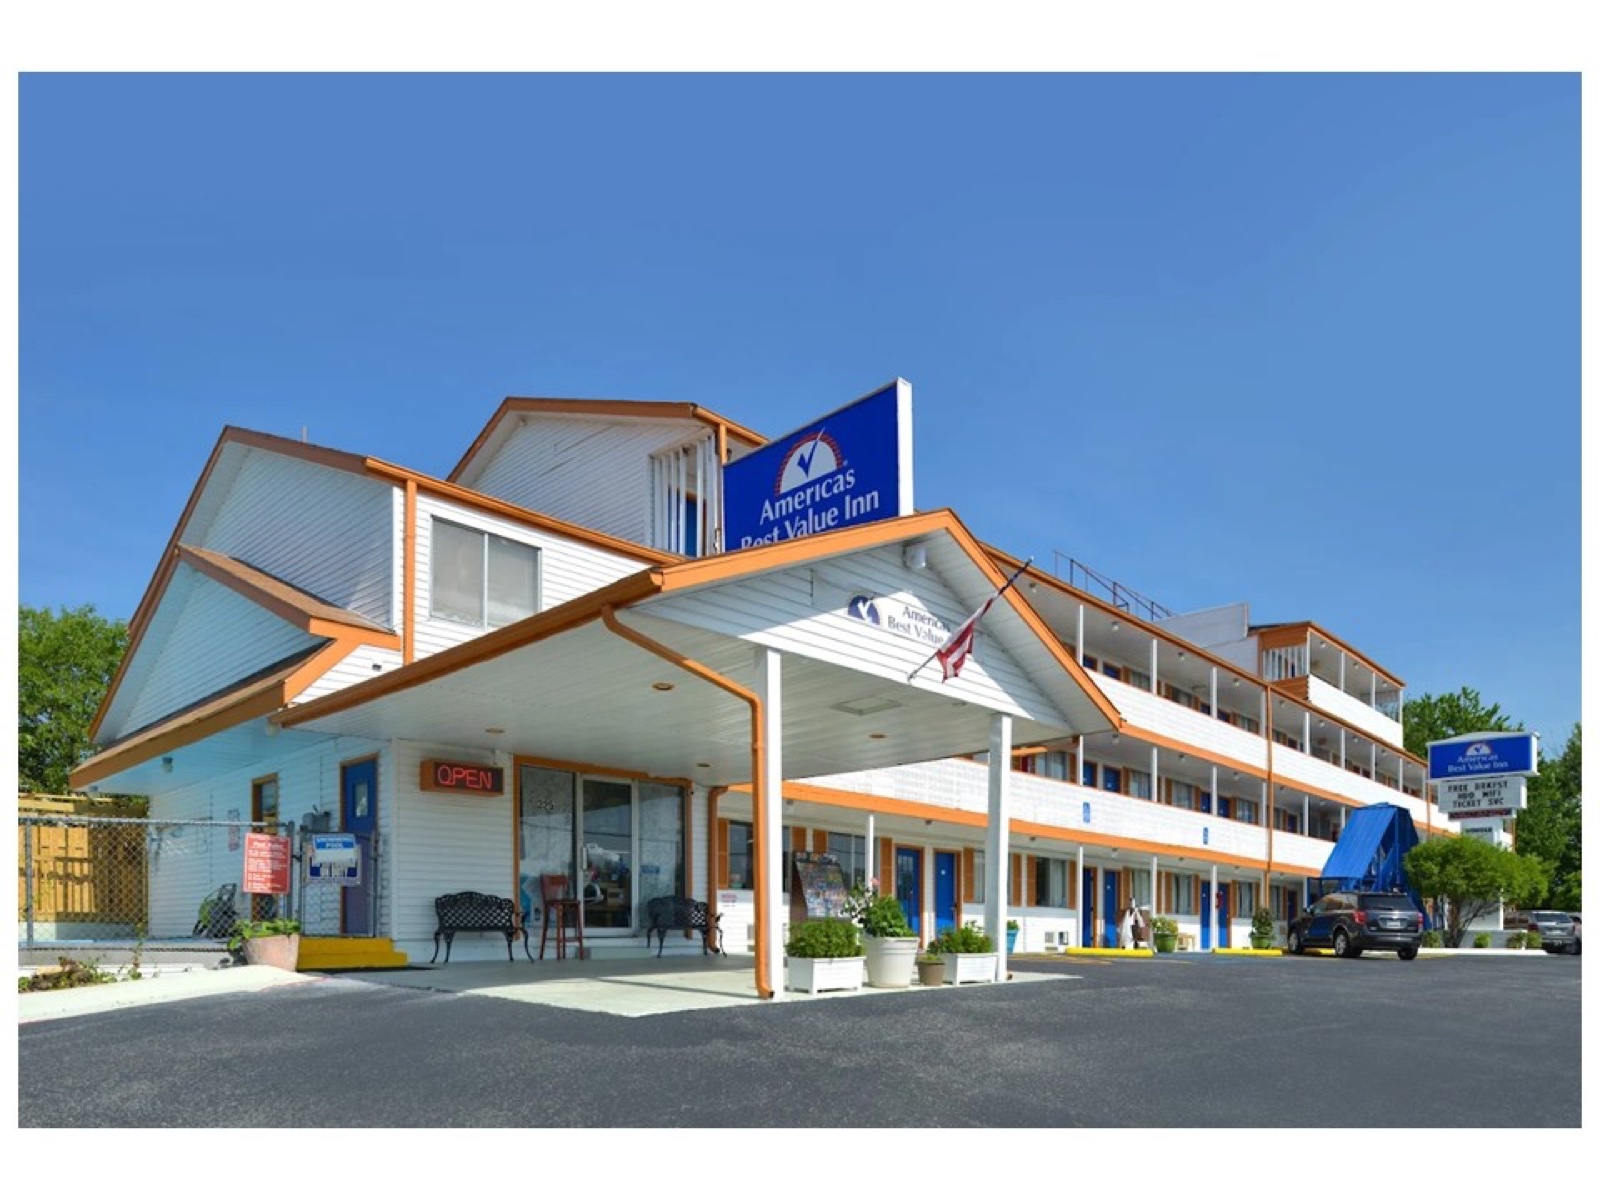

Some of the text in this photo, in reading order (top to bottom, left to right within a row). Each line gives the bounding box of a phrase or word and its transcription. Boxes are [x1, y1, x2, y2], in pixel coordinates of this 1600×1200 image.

[759, 469, 856, 526] Americas
[784, 506, 839, 539] Value
[844, 489, 880, 520] Inn
[887, 615, 944, 644] Best Value
[1447, 764, 1466, 773] Best
[1492, 761, 1509, 769] Inn
[437, 764, 493, 790] OPEN
[1447, 784, 1468, 792] FREE
[1457, 791, 1475, 799] HBO
[1453, 799, 1481, 808] TICKET
